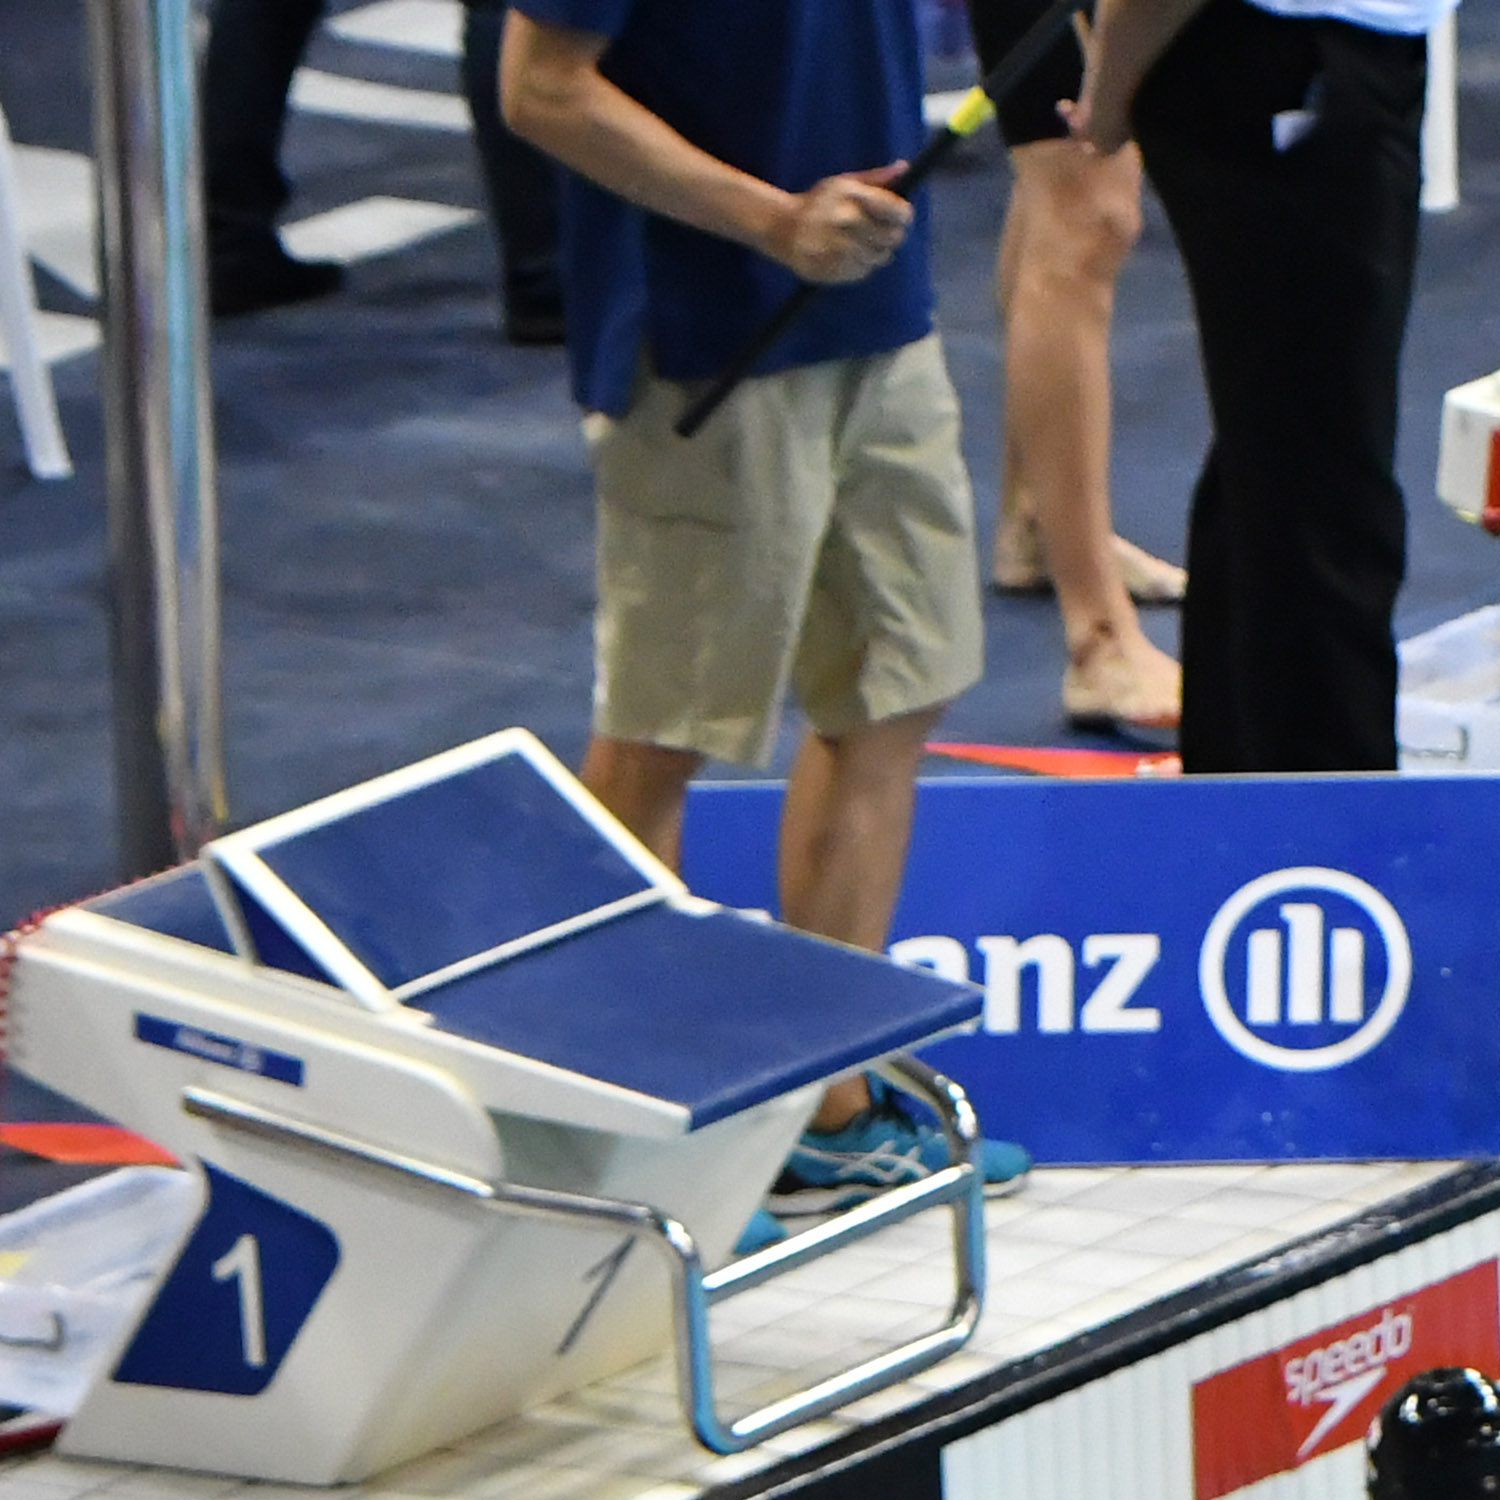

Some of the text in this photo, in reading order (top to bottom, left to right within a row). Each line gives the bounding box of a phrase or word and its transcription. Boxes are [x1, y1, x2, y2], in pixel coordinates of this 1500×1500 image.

[211, 1233, 267, 1368] 1
[558, 1234, 637, 1355] 1
[1285, 1307, 1413, 1407] speedo
